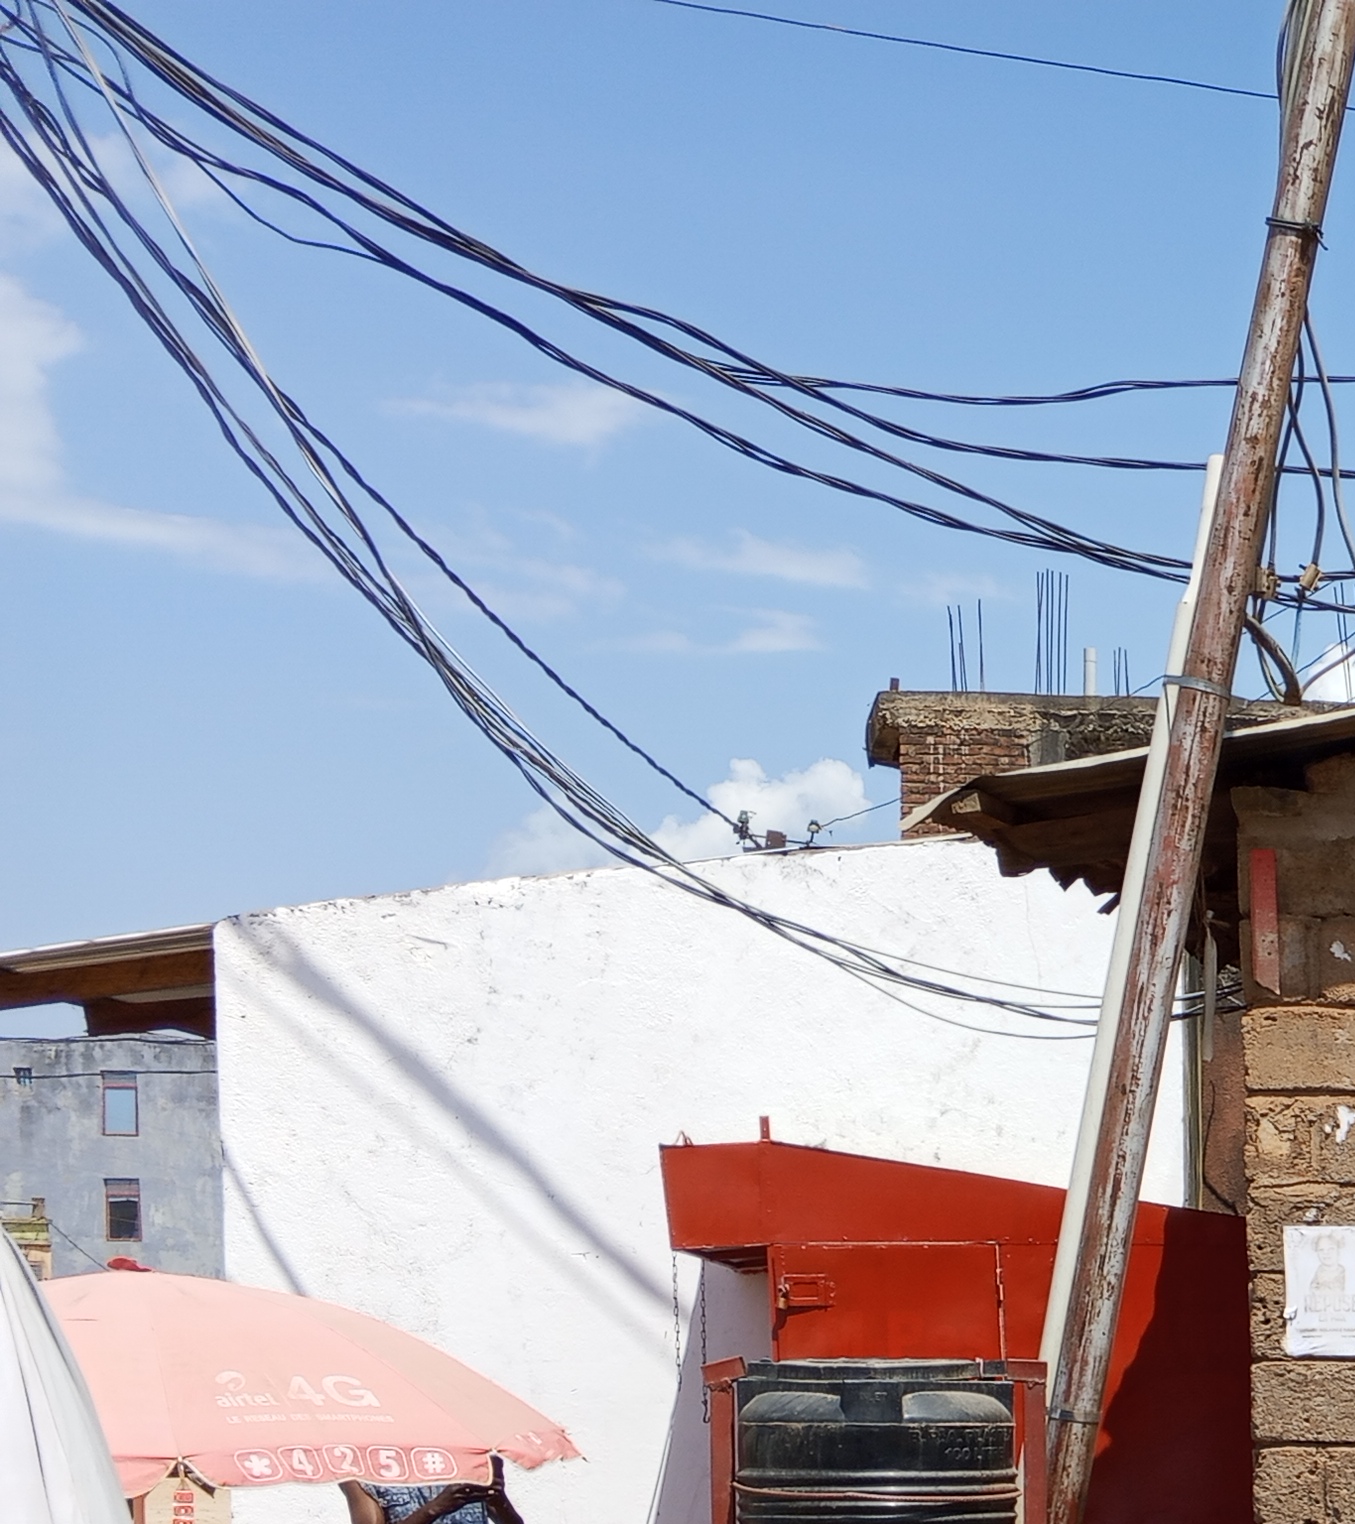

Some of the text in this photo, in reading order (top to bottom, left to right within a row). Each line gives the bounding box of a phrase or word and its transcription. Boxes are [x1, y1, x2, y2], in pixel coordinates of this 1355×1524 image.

[214, 1375, 381, 1408] airtel 4G
[225, 1415, 242, 1425] LE
